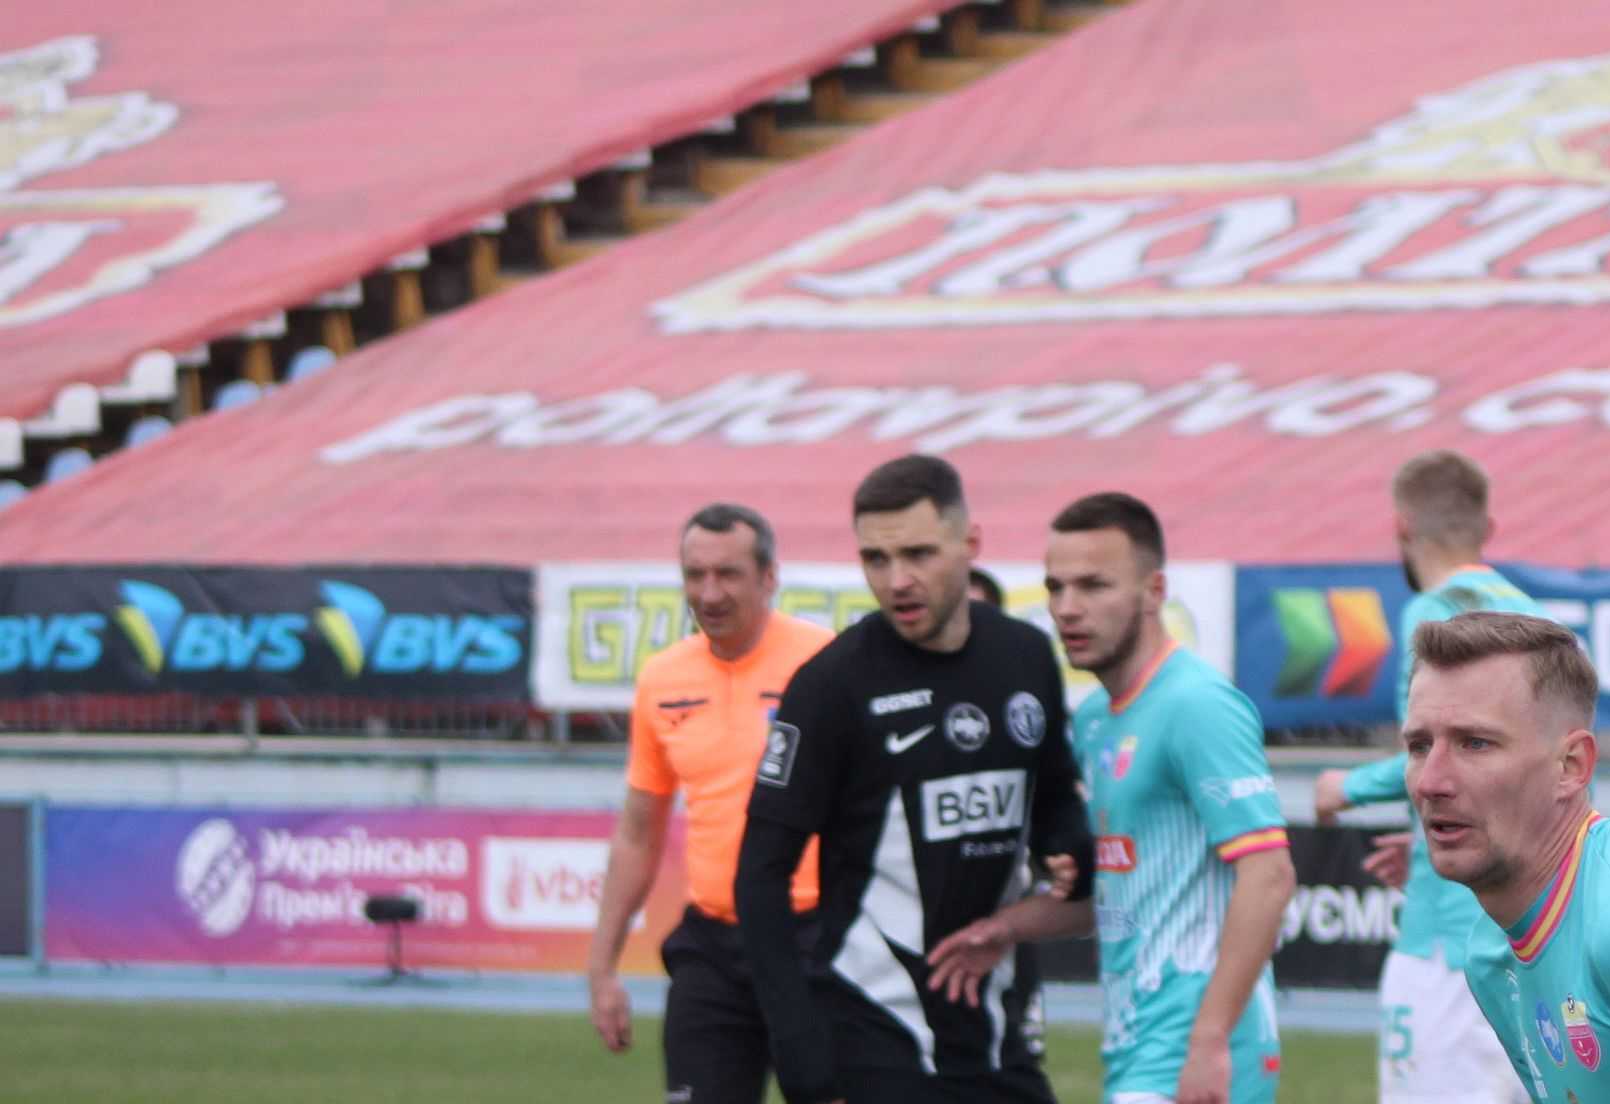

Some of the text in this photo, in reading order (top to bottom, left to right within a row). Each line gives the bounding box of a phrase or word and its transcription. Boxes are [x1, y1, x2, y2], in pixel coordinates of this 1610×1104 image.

[171, 614, 307, 672] BVS
[372, 614, 525, 672] BVS
[937, 783, 1016, 828] BGV
[258, 825, 469, 882] Українська
